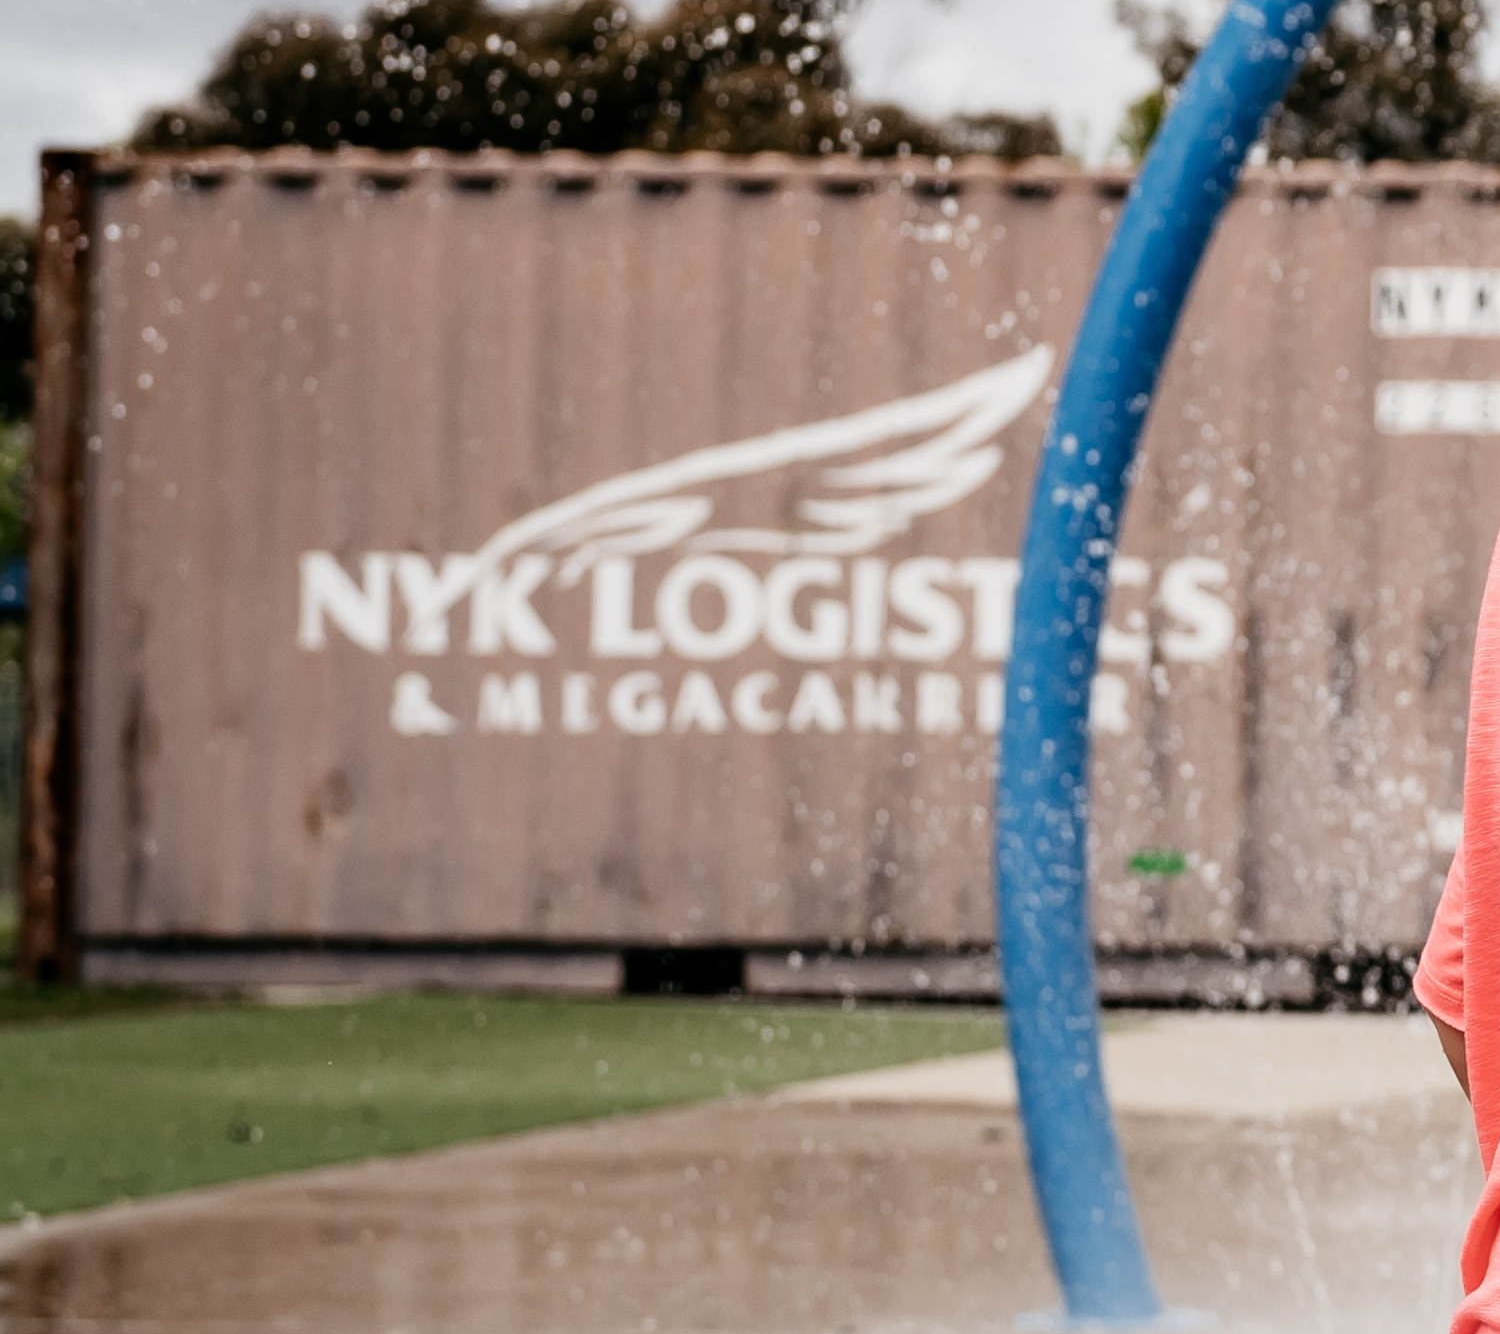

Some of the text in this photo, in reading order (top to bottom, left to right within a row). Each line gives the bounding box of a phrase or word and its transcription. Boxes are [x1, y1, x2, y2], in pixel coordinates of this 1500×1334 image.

[298, 551, 1236, 661] NYK LOGISTCS
[391, 670, 460, 735] &
